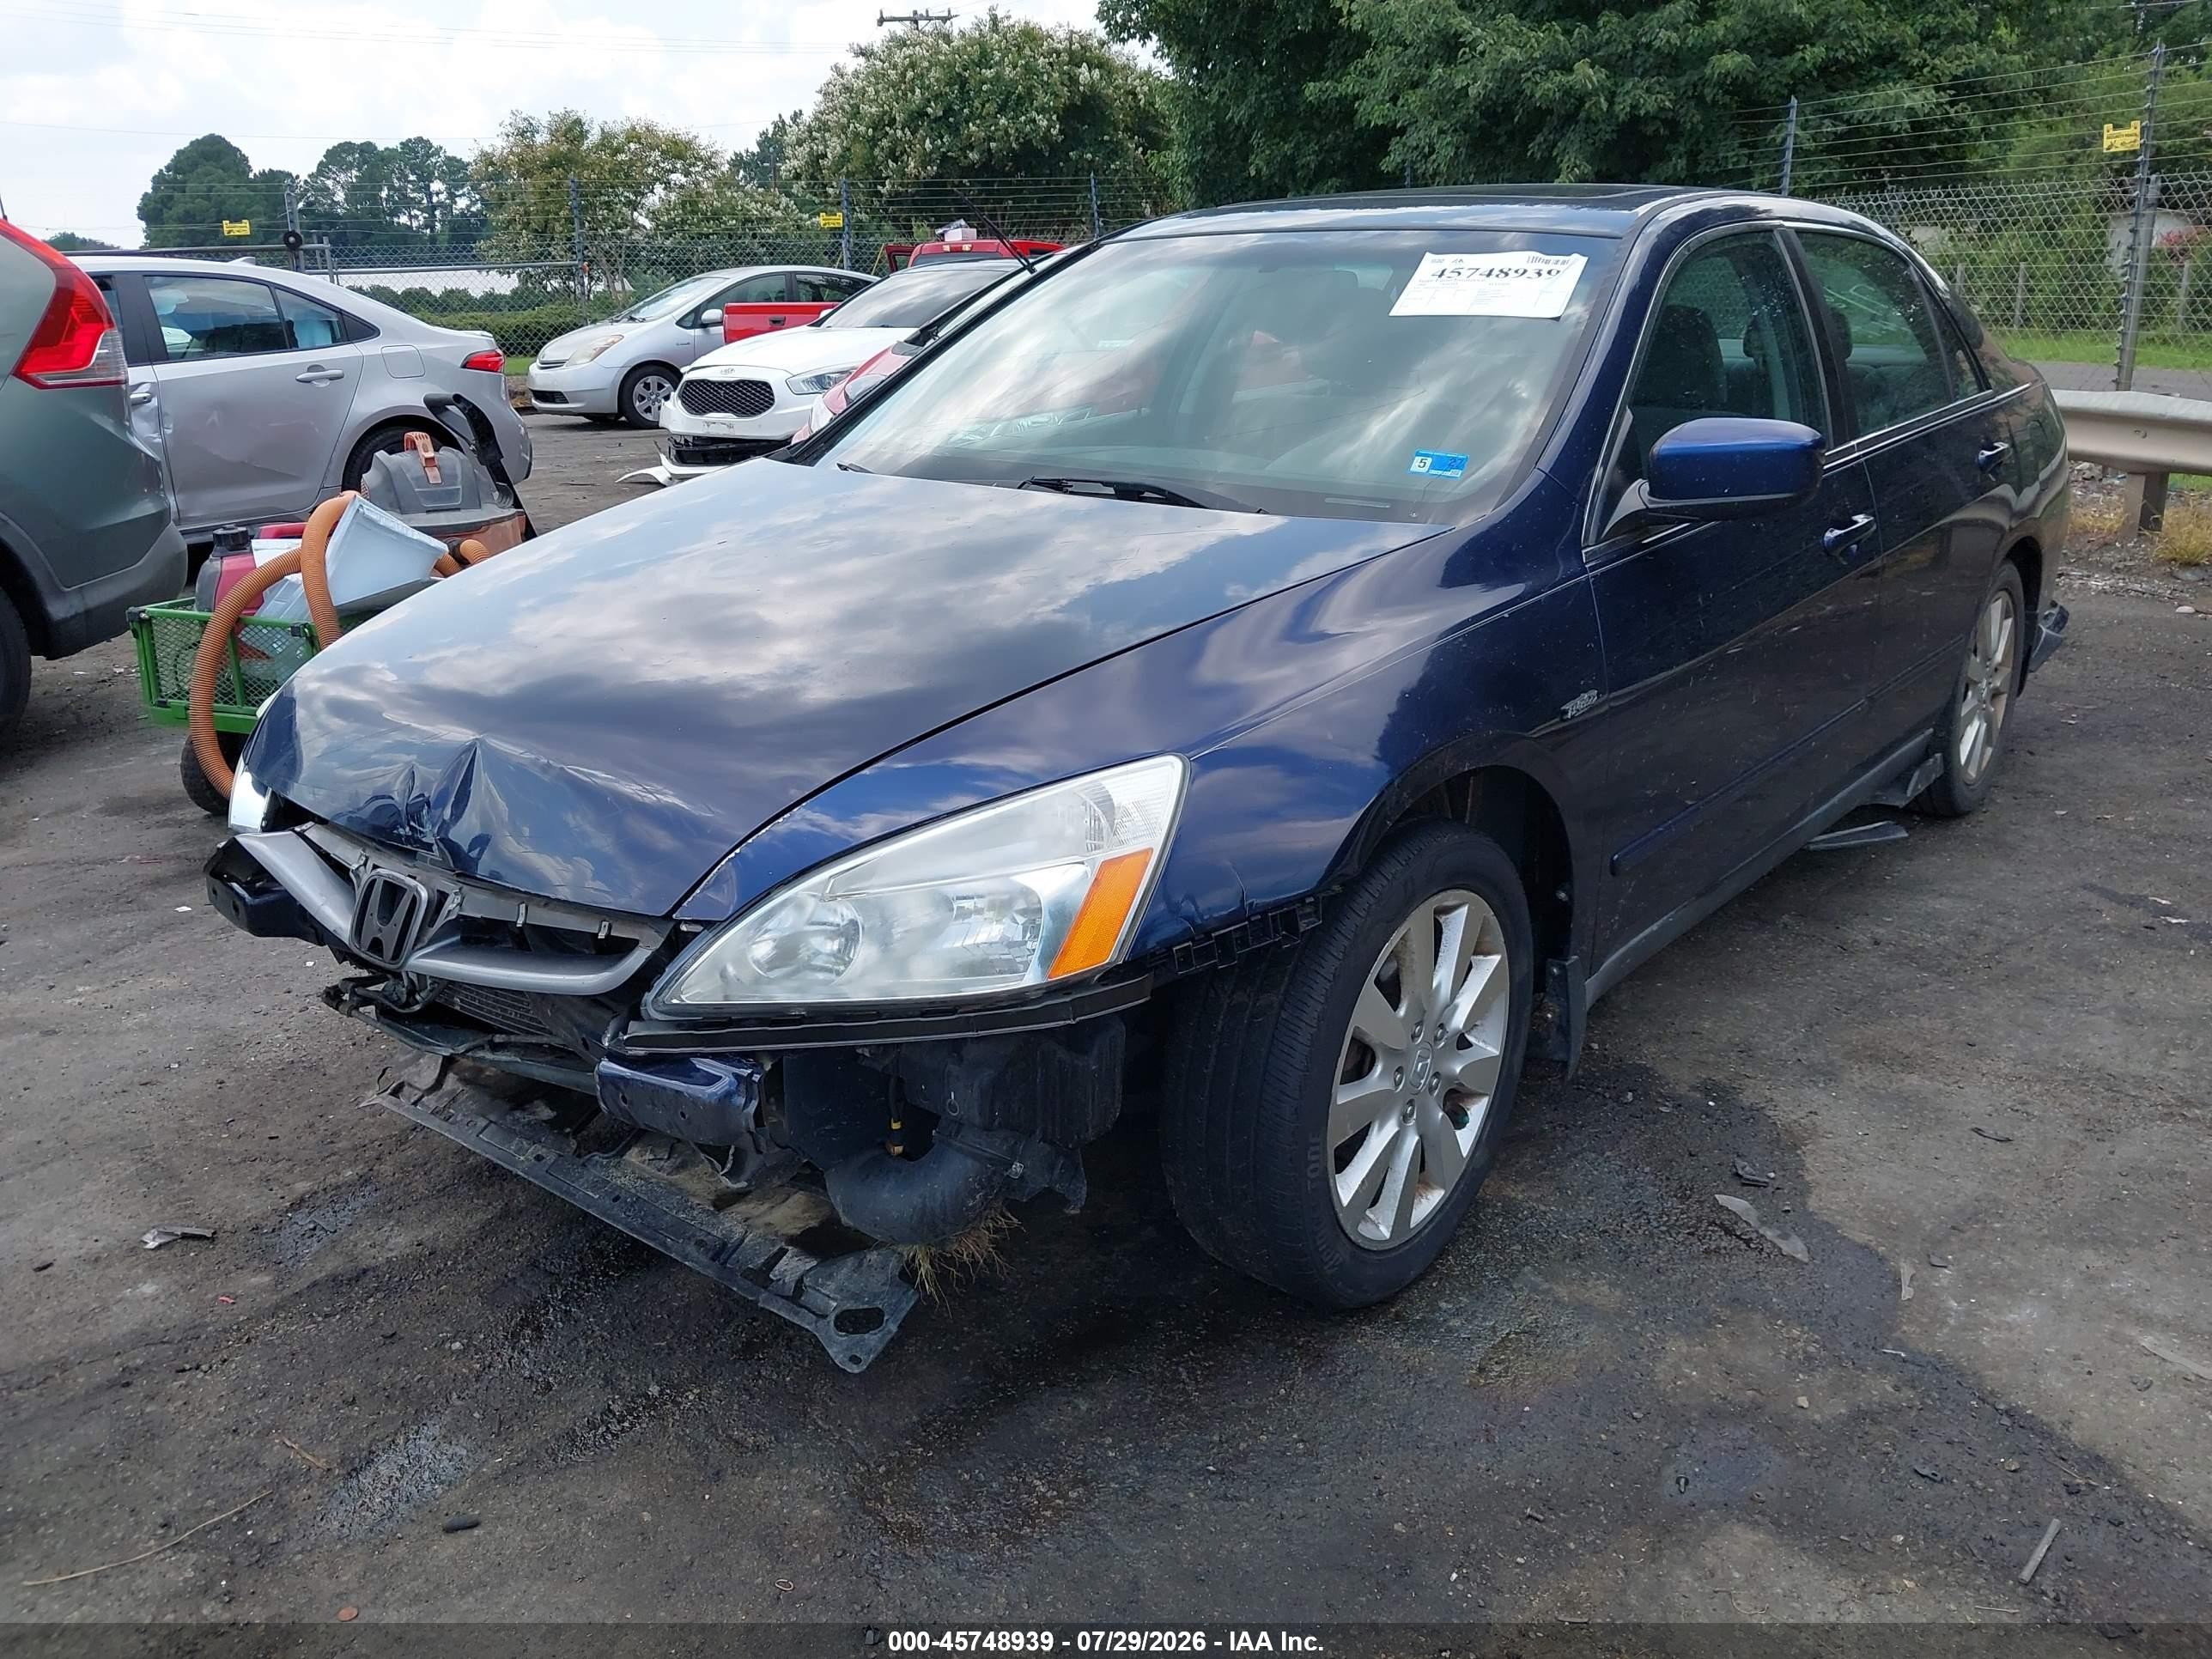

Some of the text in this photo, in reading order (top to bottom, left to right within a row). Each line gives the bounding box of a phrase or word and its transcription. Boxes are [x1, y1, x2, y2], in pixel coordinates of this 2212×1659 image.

[1431, 267, 1561, 280] 45748939
[1417, 458, 1465, 469] 5 27
